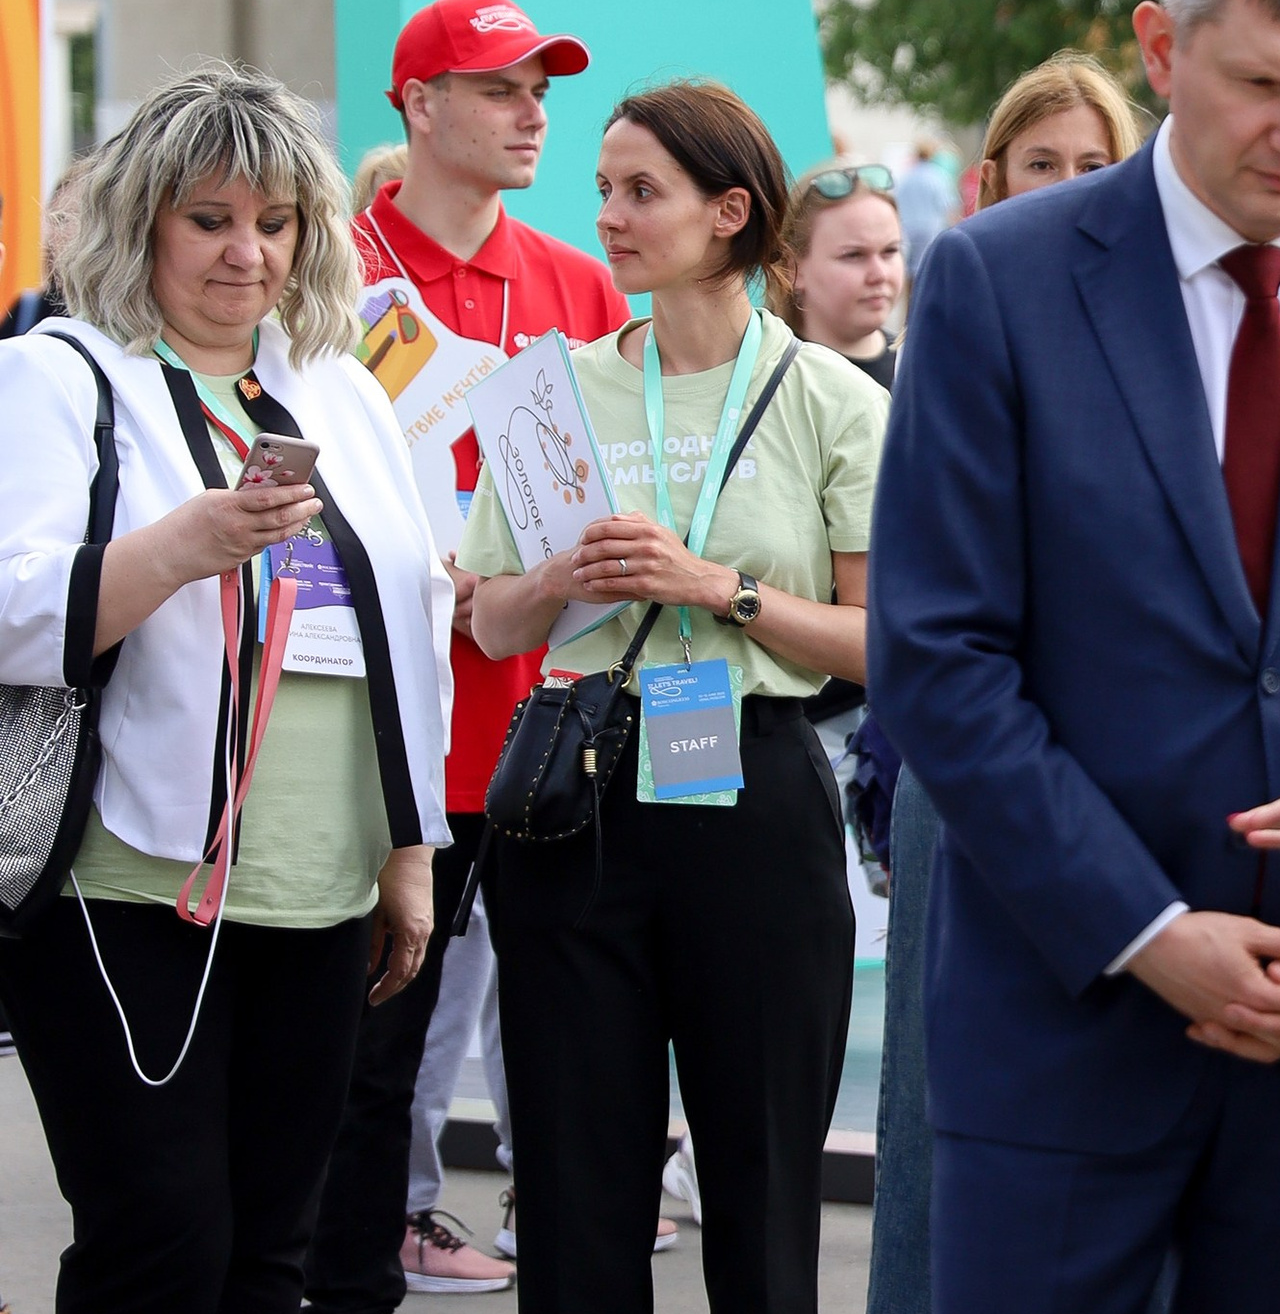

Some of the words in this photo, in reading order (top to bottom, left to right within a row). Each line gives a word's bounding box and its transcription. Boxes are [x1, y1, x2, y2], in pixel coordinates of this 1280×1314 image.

[511, 446, 543, 531] ЗОЛОТОЕ
[301, 623, 338, 633] АЛЕКСЕЕВА
[292, 653, 353, 666] КООРДИНАТОР
[670, 735, 718, 753] STAFF
